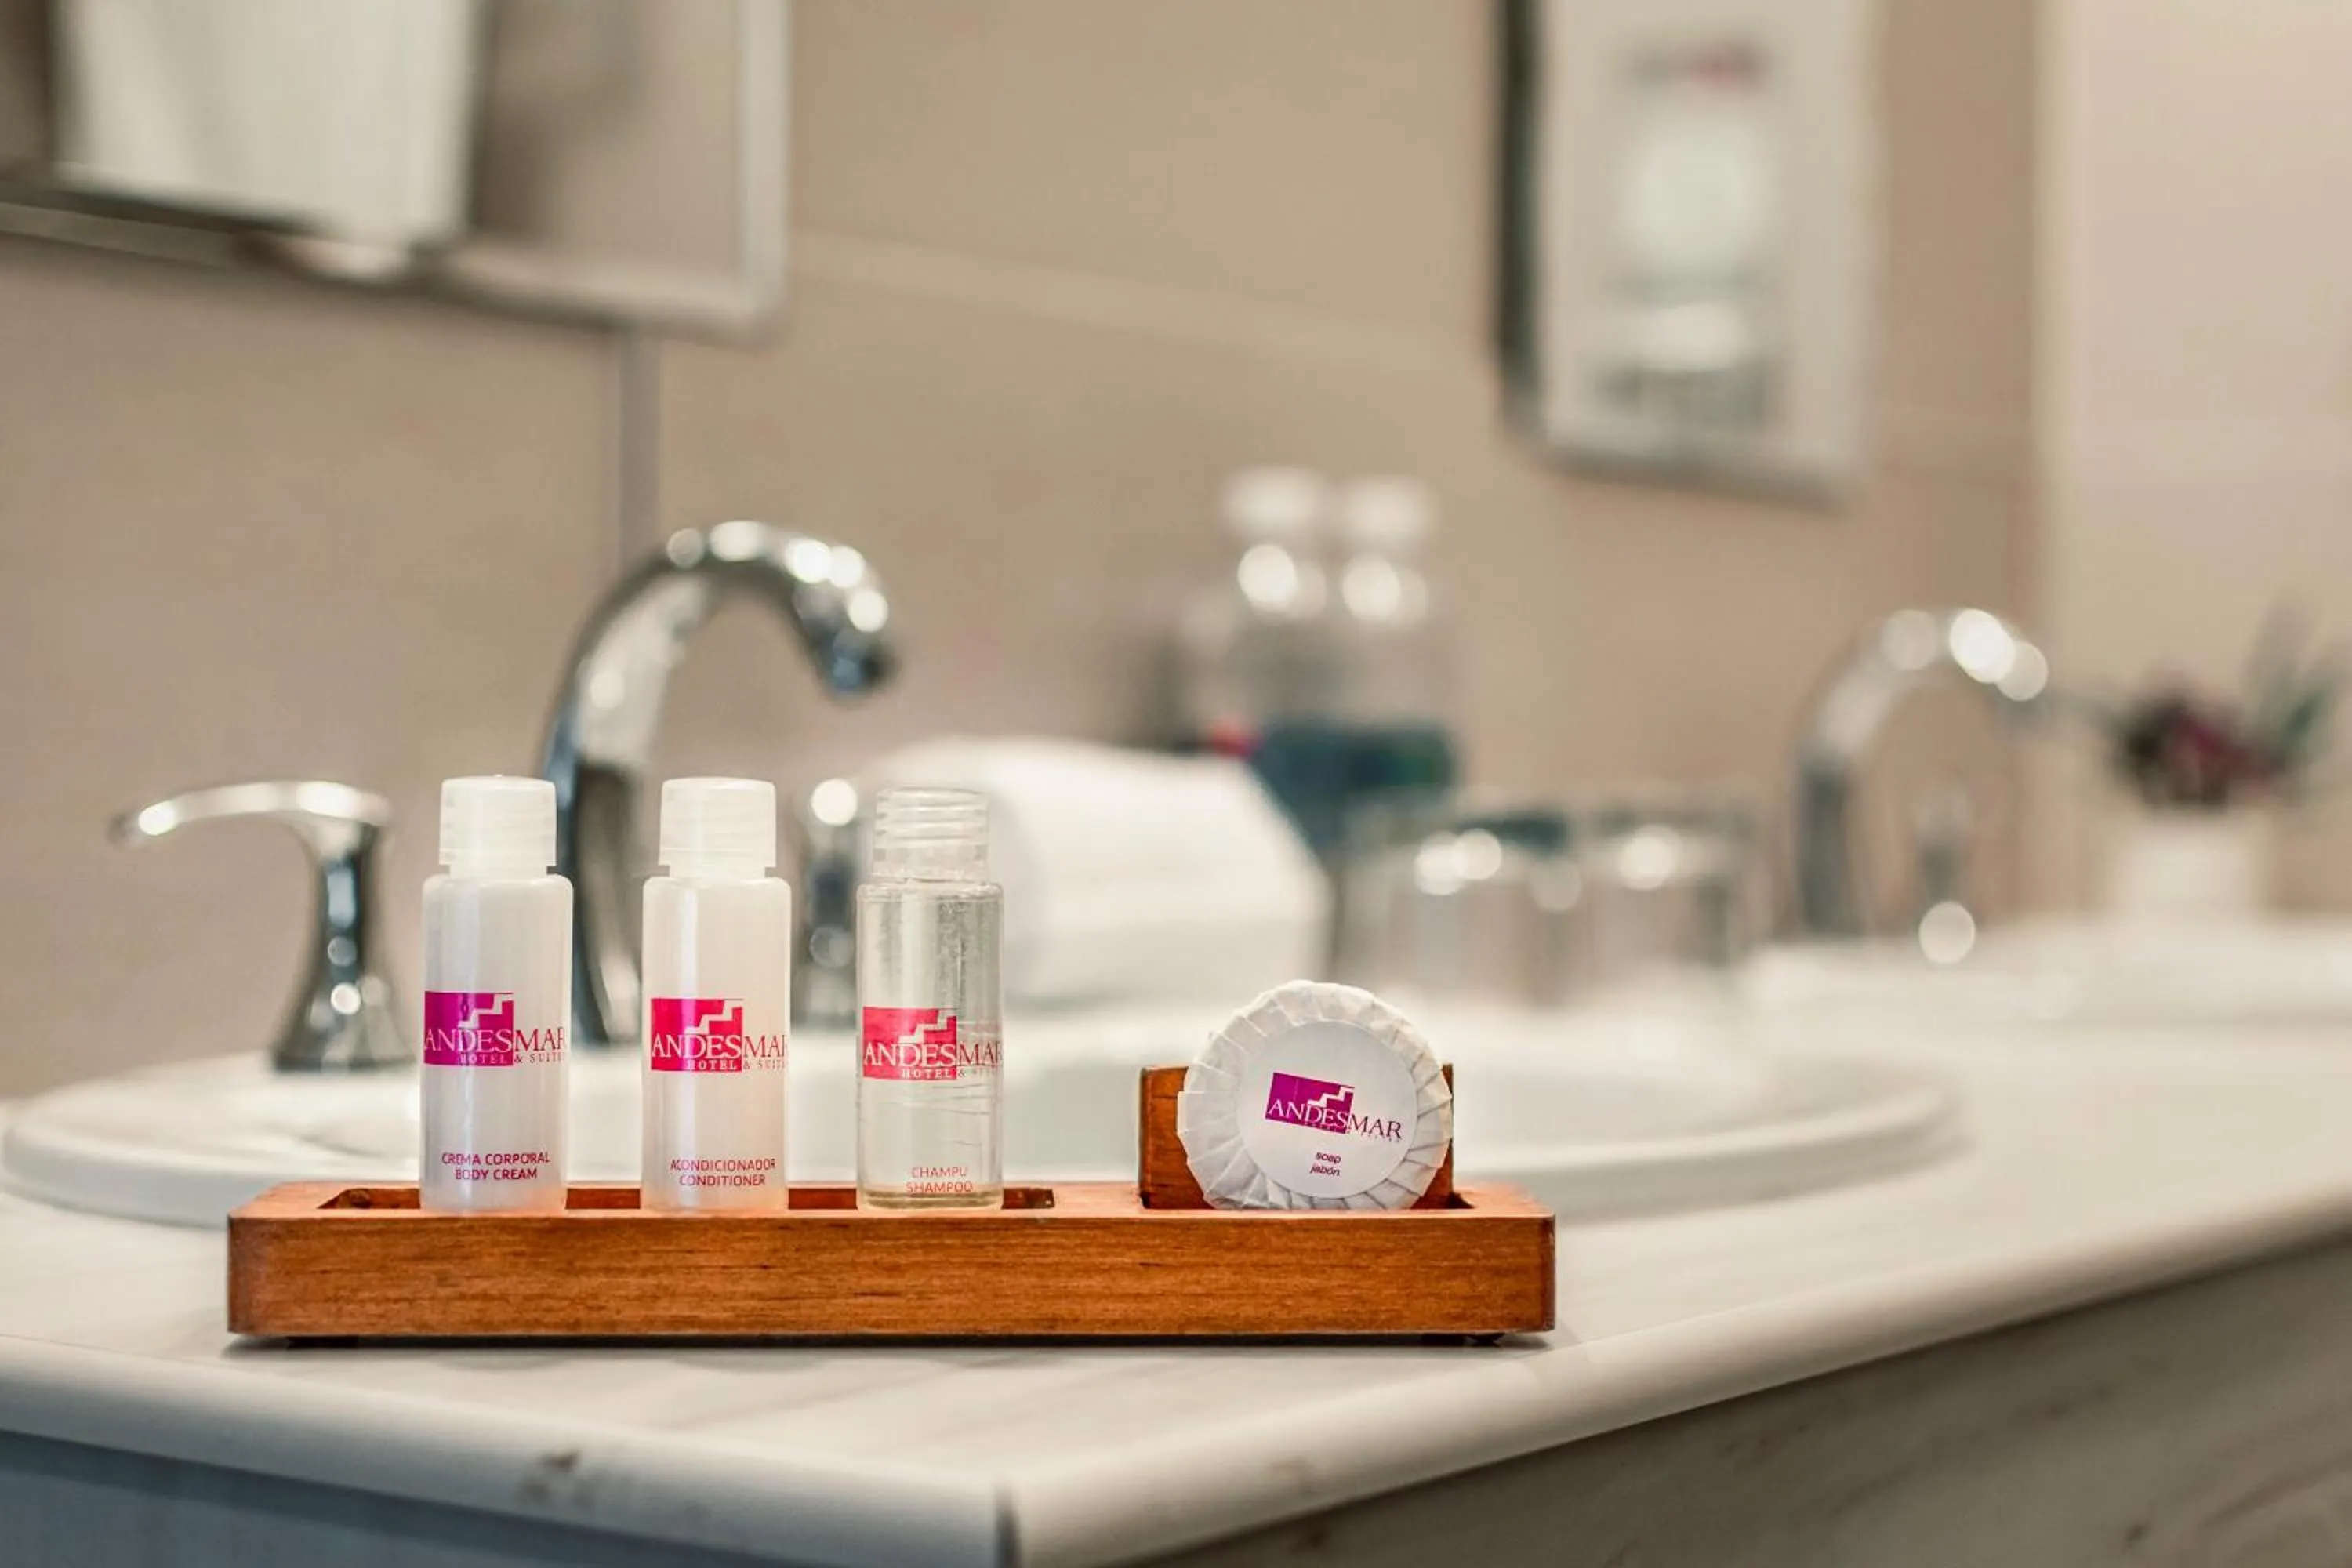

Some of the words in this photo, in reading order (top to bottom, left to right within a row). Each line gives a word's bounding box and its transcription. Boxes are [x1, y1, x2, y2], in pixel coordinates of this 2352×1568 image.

[459, 1054, 508, 1065] HOTEL
[514, 1054, 523, 1064] &
[687, 1059, 738, 1070] HOTEL
[902, 1067, 952, 1078] HOTEL
[1268, 1098, 1402, 1140] ANDESMAR
[441, 1152, 481, 1165] CREMA
[485, 1152, 551, 1166] CORPORAL
[1315, 1151, 1341, 1164] soap
[670, 1157, 776, 1172] ACONDICIONADOR
[1309, 1163, 1341, 1177] jabón
[455, 1168, 490, 1181] BODY
[493, 1167, 538, 1180] CREAM
[679, 1174, 766, 1187] CONDITIONER
[906, 1180, 973, 1192] SHAMPOO
